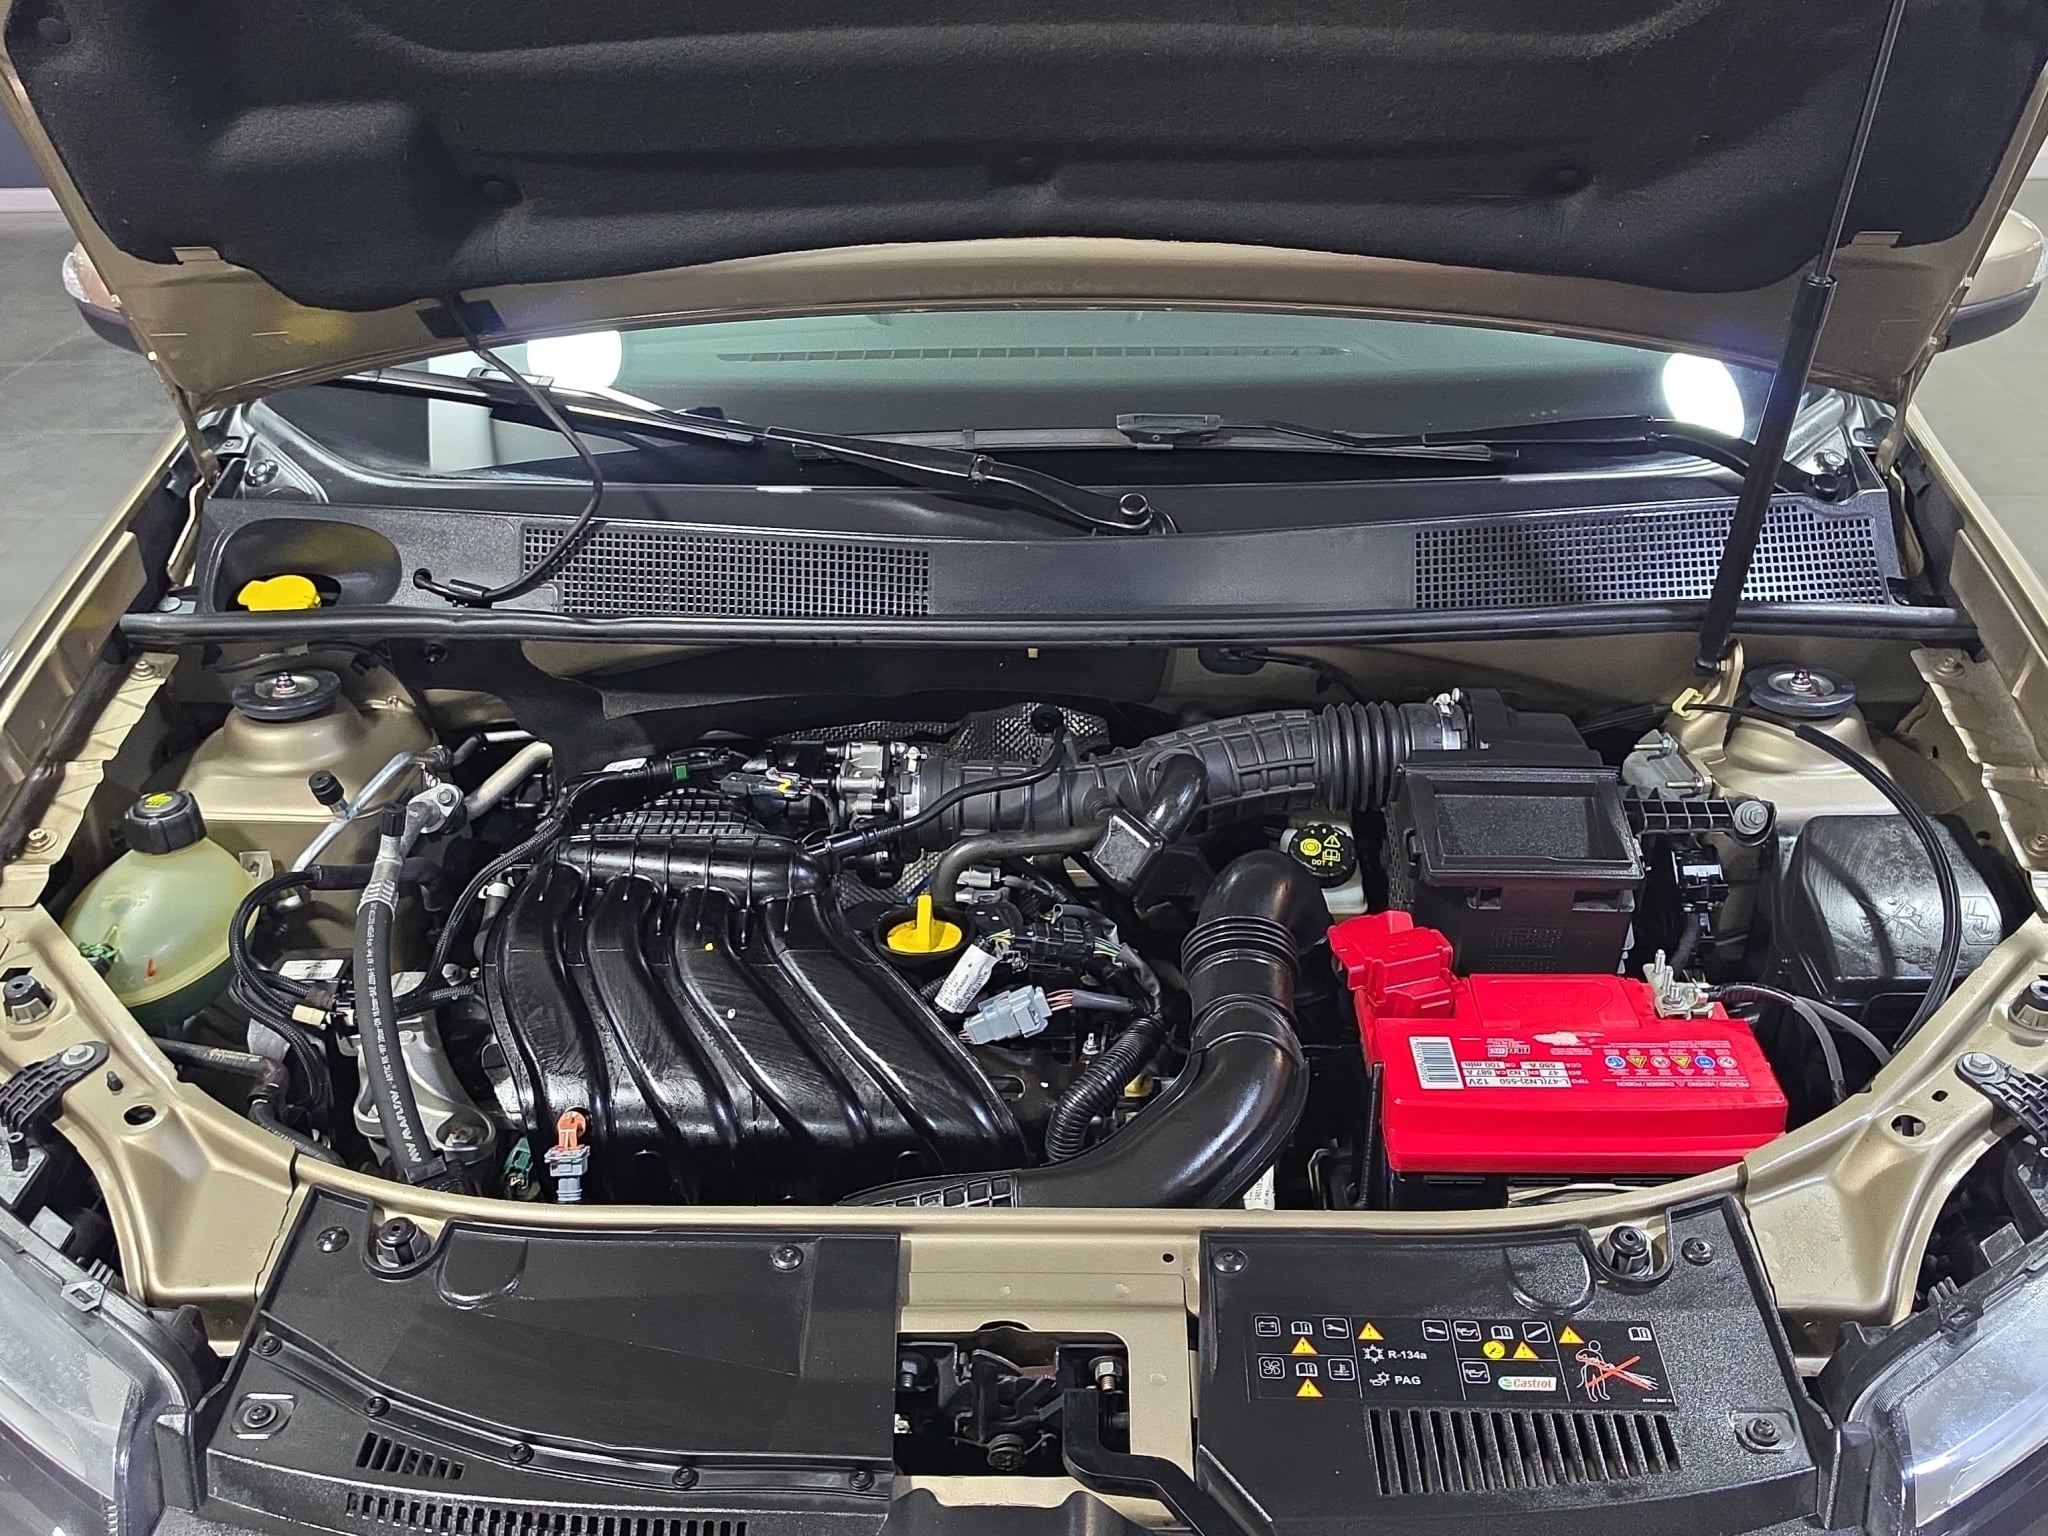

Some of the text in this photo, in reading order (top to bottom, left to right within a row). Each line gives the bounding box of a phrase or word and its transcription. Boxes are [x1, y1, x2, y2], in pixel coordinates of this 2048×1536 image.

[1468, 1078, 1489, 1086] 12V
[1499, 1076, 1569, 1085] L-47(LN2)-550
[1387, 1350, 1428, 1360] R-134a
[1394, 1375, 1422, 1386] PAG
[1513, 1377, 1553, 1389] Castrol
